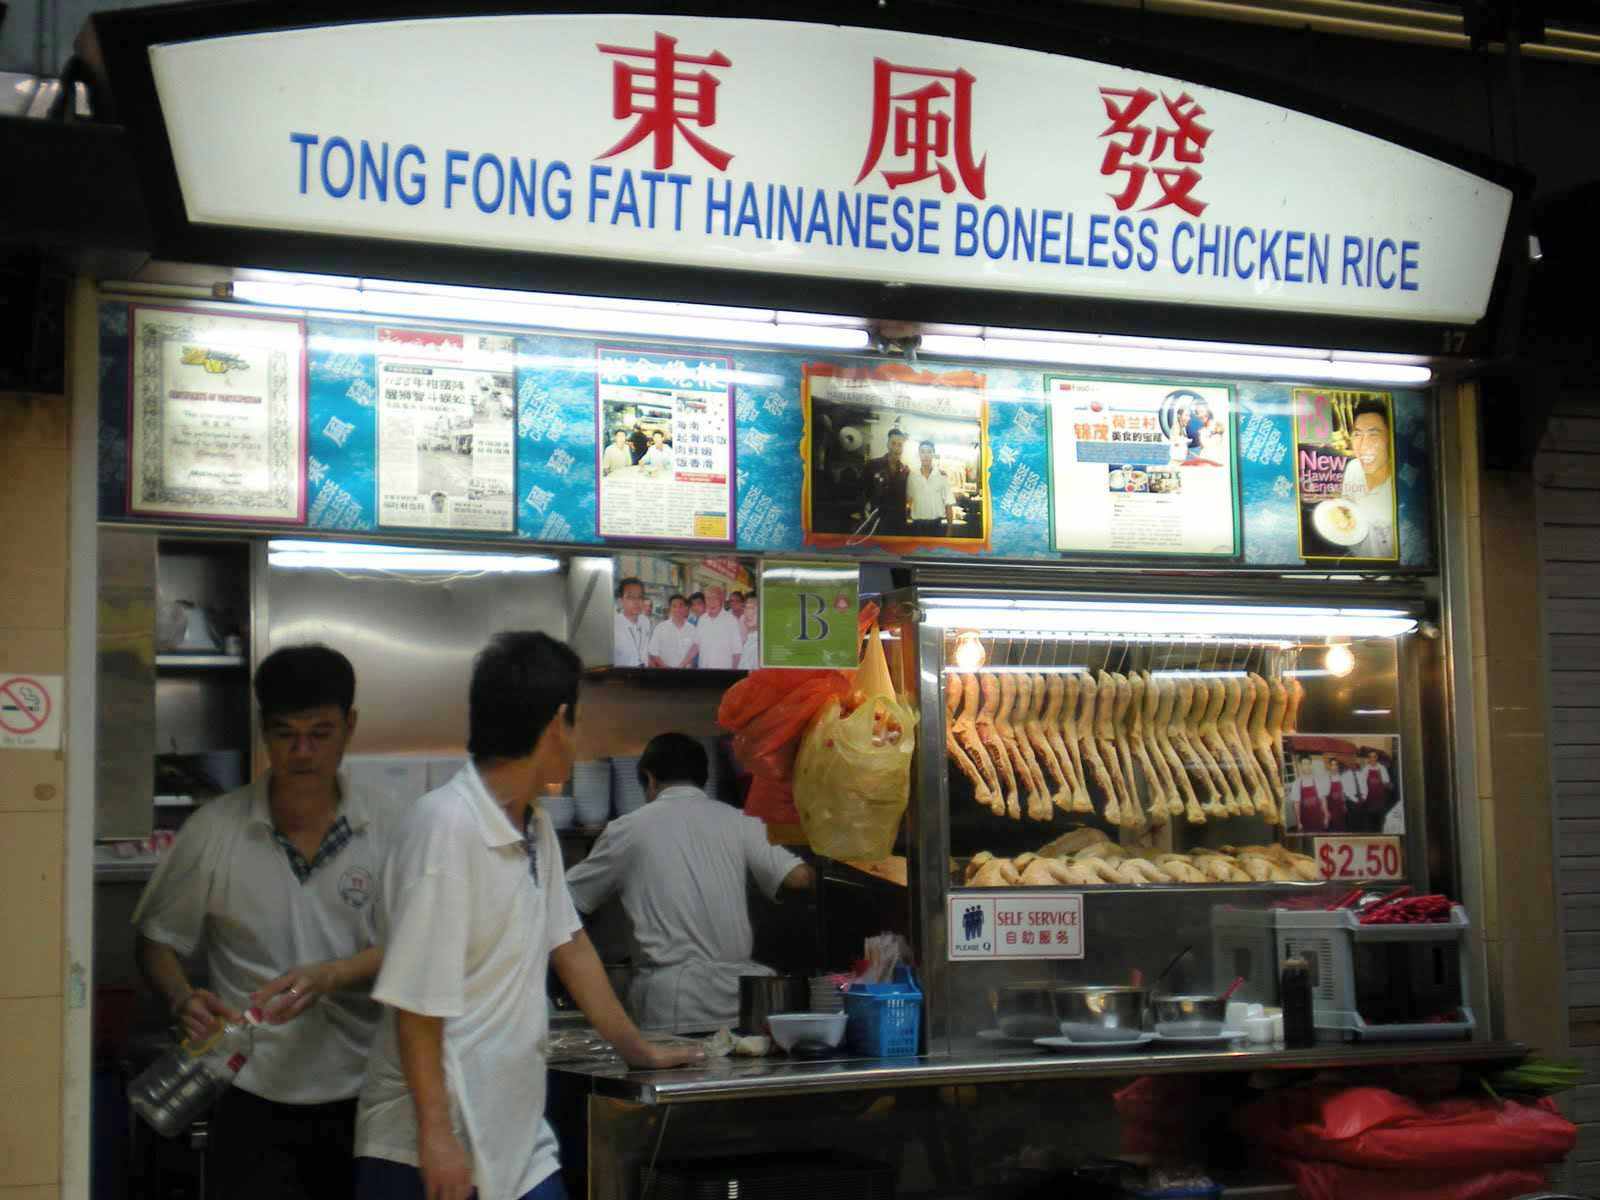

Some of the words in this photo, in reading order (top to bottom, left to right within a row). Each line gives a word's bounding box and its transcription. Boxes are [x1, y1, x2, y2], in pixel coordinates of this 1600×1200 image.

[289, 131, 427, 206] TONG
[443, 149, 573, 220] FONG
[588, 164, 692, 232] FATT
[705, 176, 941, 254] HAINANESE
[955, 202, 1159, 271] BONELESS
[1171, 220, 1329, 284] CHICKEN
[1341, 235, 1420, 291] RICE
[1299, 449, 1347, 472] New
[1301, 469, 1345, 482] Hawke
[796, 591, 830, 640] B
[1318, 843, 1399, 880] $2.50
[997, 911, 1023, 926] SELF
[1028, 910, 1078, 927] SERVICE
[955, 944, 980, 952] PLEASE
[982, 942, 992, 952] Q
[1006, 930, 1069, 945] 自助服务
